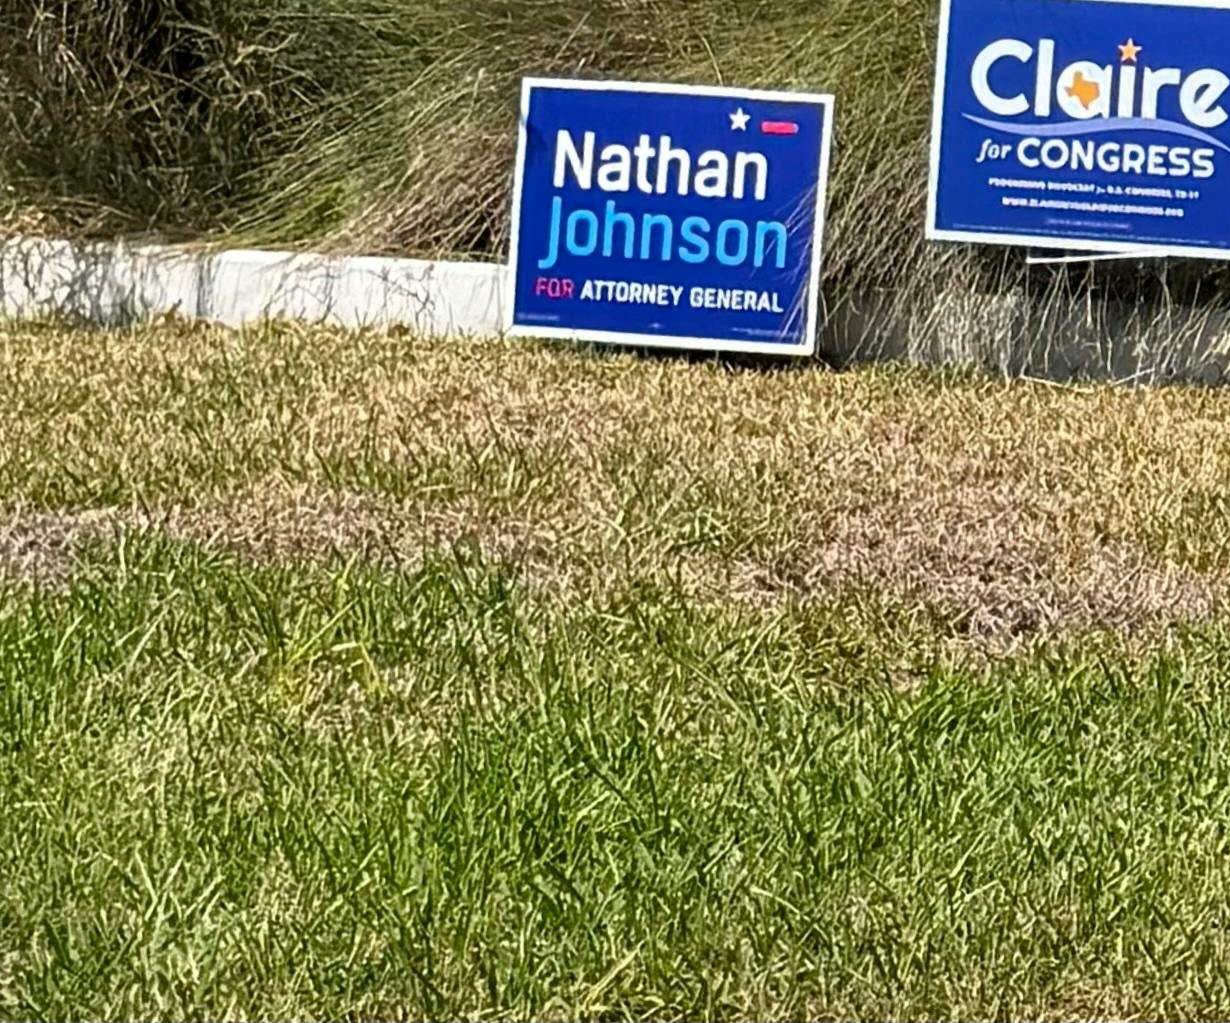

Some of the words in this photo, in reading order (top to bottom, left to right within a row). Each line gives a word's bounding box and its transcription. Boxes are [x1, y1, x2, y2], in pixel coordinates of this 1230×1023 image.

[971, 38, 1230, 128] Claire
[553, 129, 768, 200] Nathan
[976, 139, 1011, 163] for
[1017, 138, 1215, 178] CONGRESS
[538, 196, 787, 269] Johnson
[536, 277, 575, 299] FOR
[580, 279, 684, 306] ATTORNEY
[689, 286, 784, 313] GENERAL
